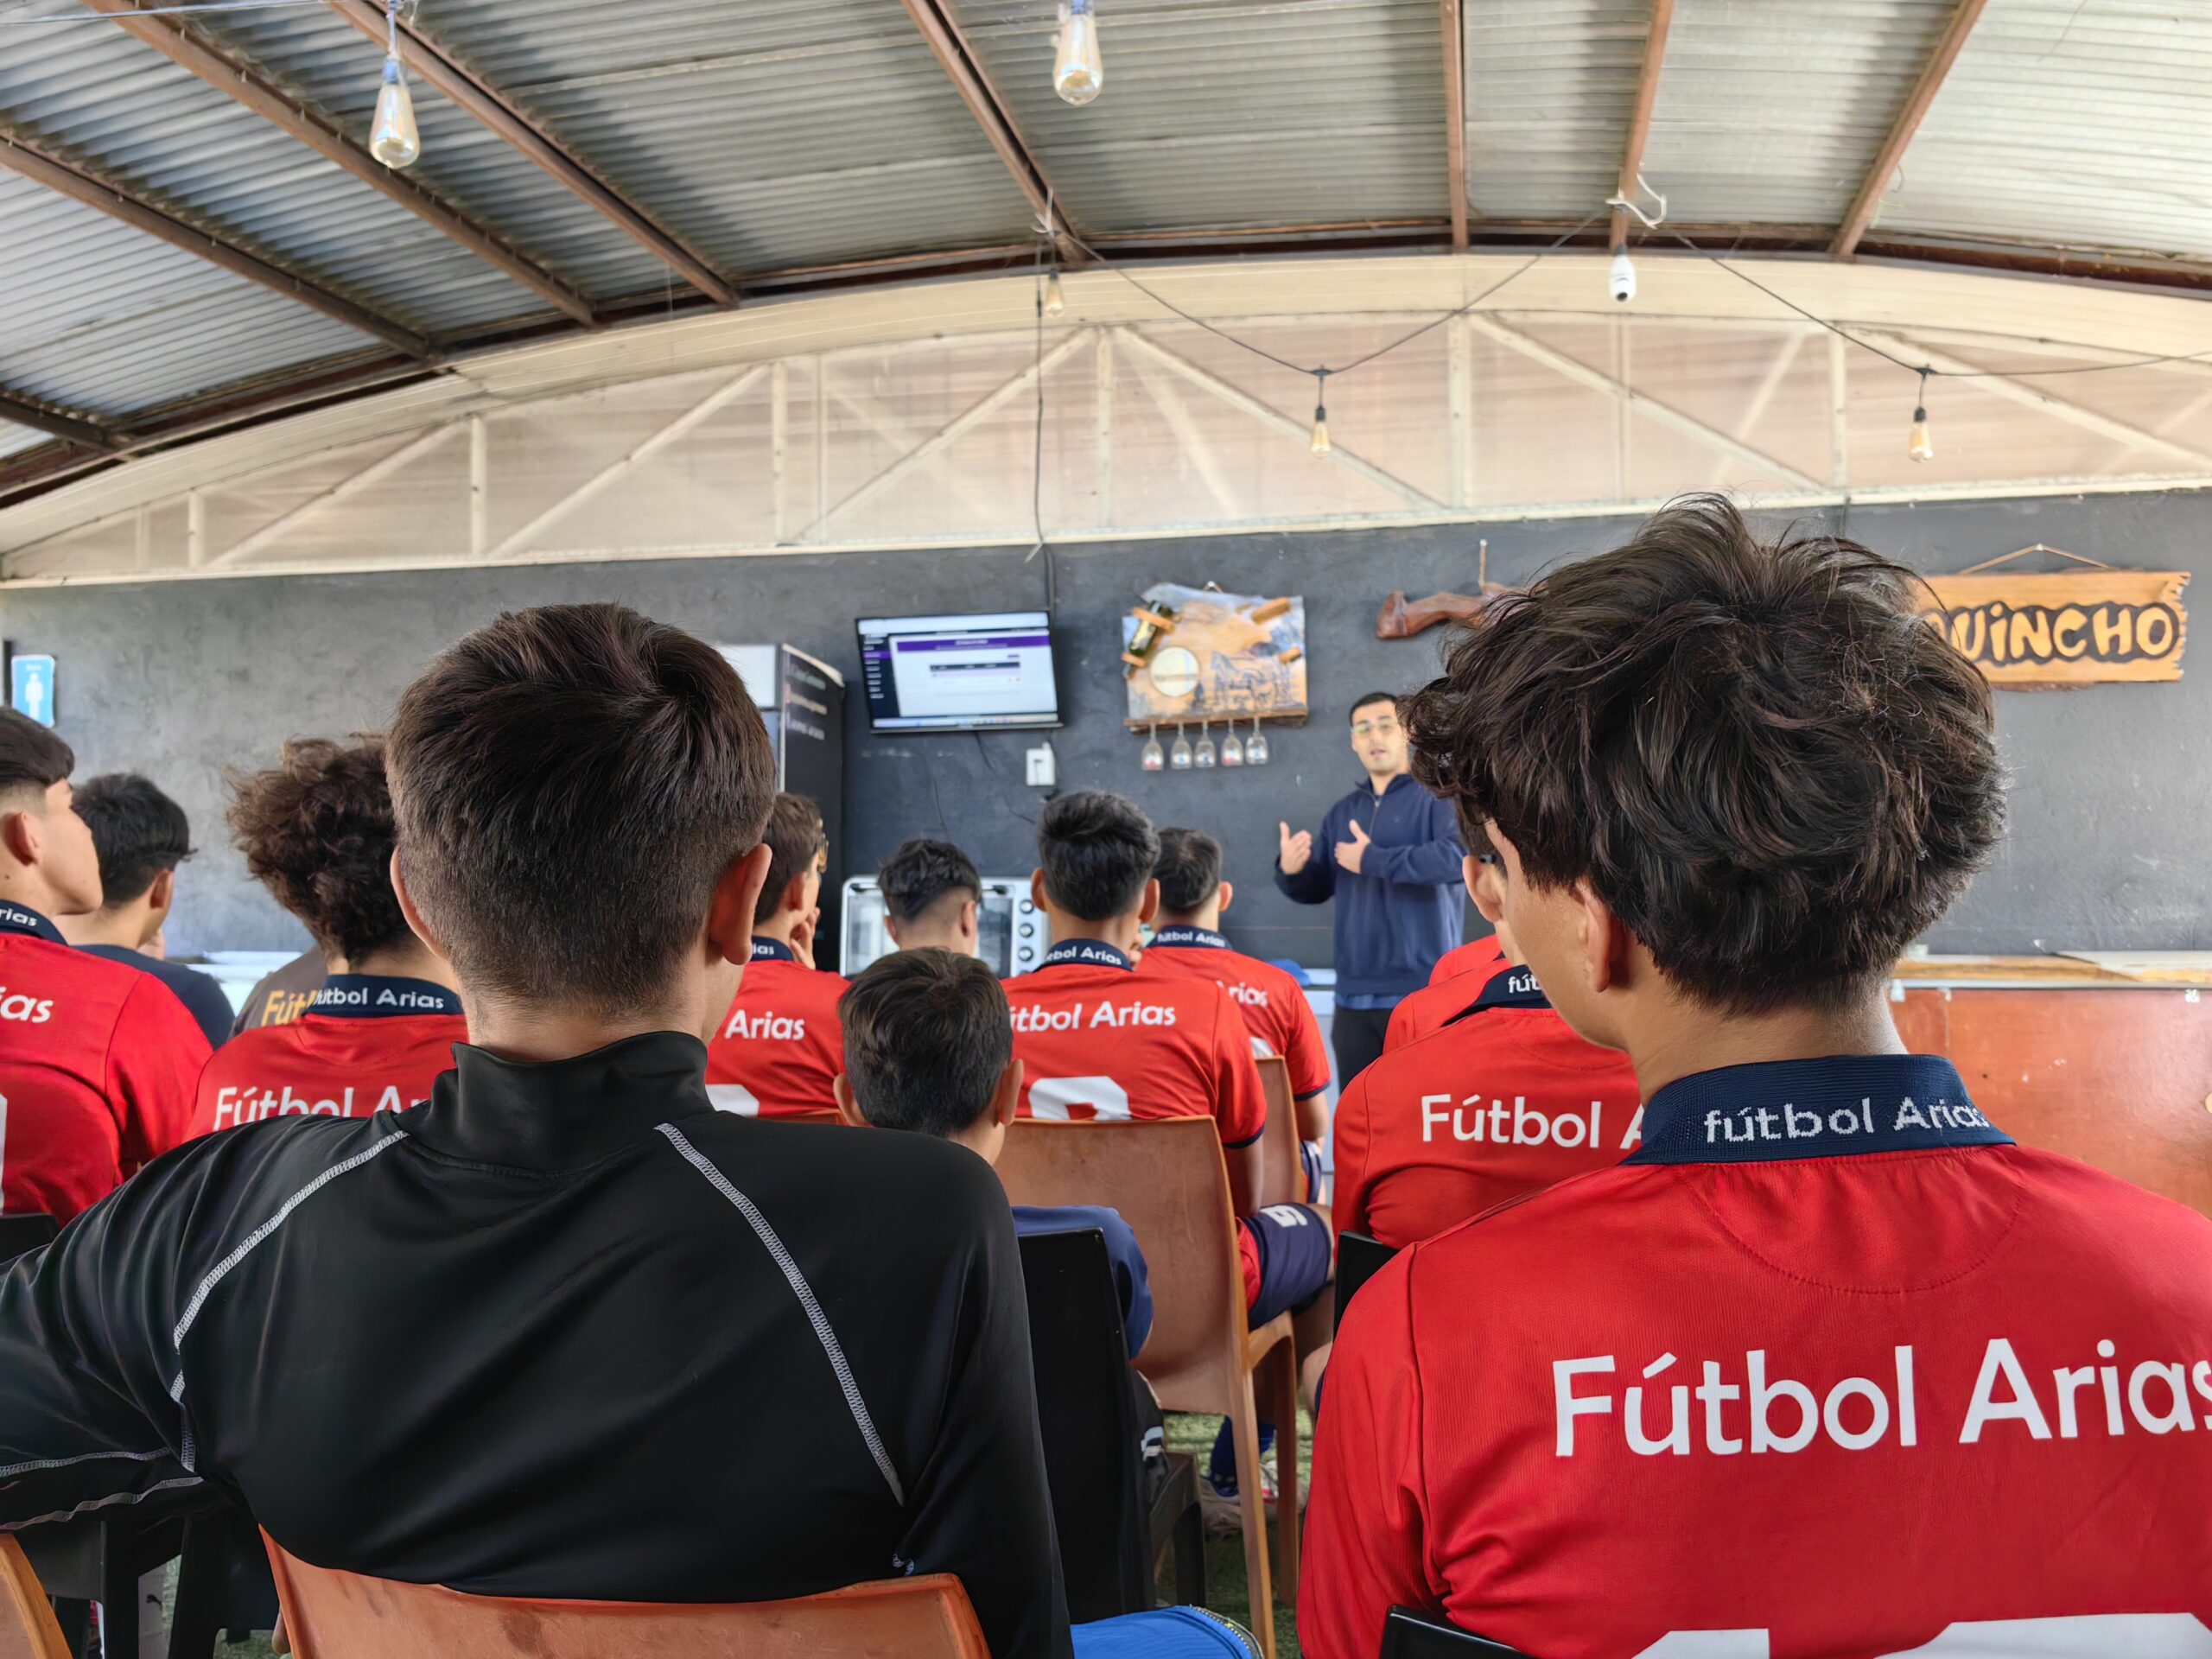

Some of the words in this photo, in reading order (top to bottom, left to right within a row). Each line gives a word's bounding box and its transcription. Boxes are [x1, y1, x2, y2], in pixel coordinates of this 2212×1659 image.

[1080, 946, 1122, 965] Arias
[1217, 980, 1268, 1007] rias
[1508, 974, 1545, 994] fút
[376, 988, 444, 1009] Arias
[725, 1009, 804, 1040] Arias
[1090, 1001, 1176, 1027] Arias
[1421, 1094, 1601, 1147] Fútbol
[1704, 1097, 1874, 1142] fútbol
[1553, 1345, 1917, 1457] Fútbol
